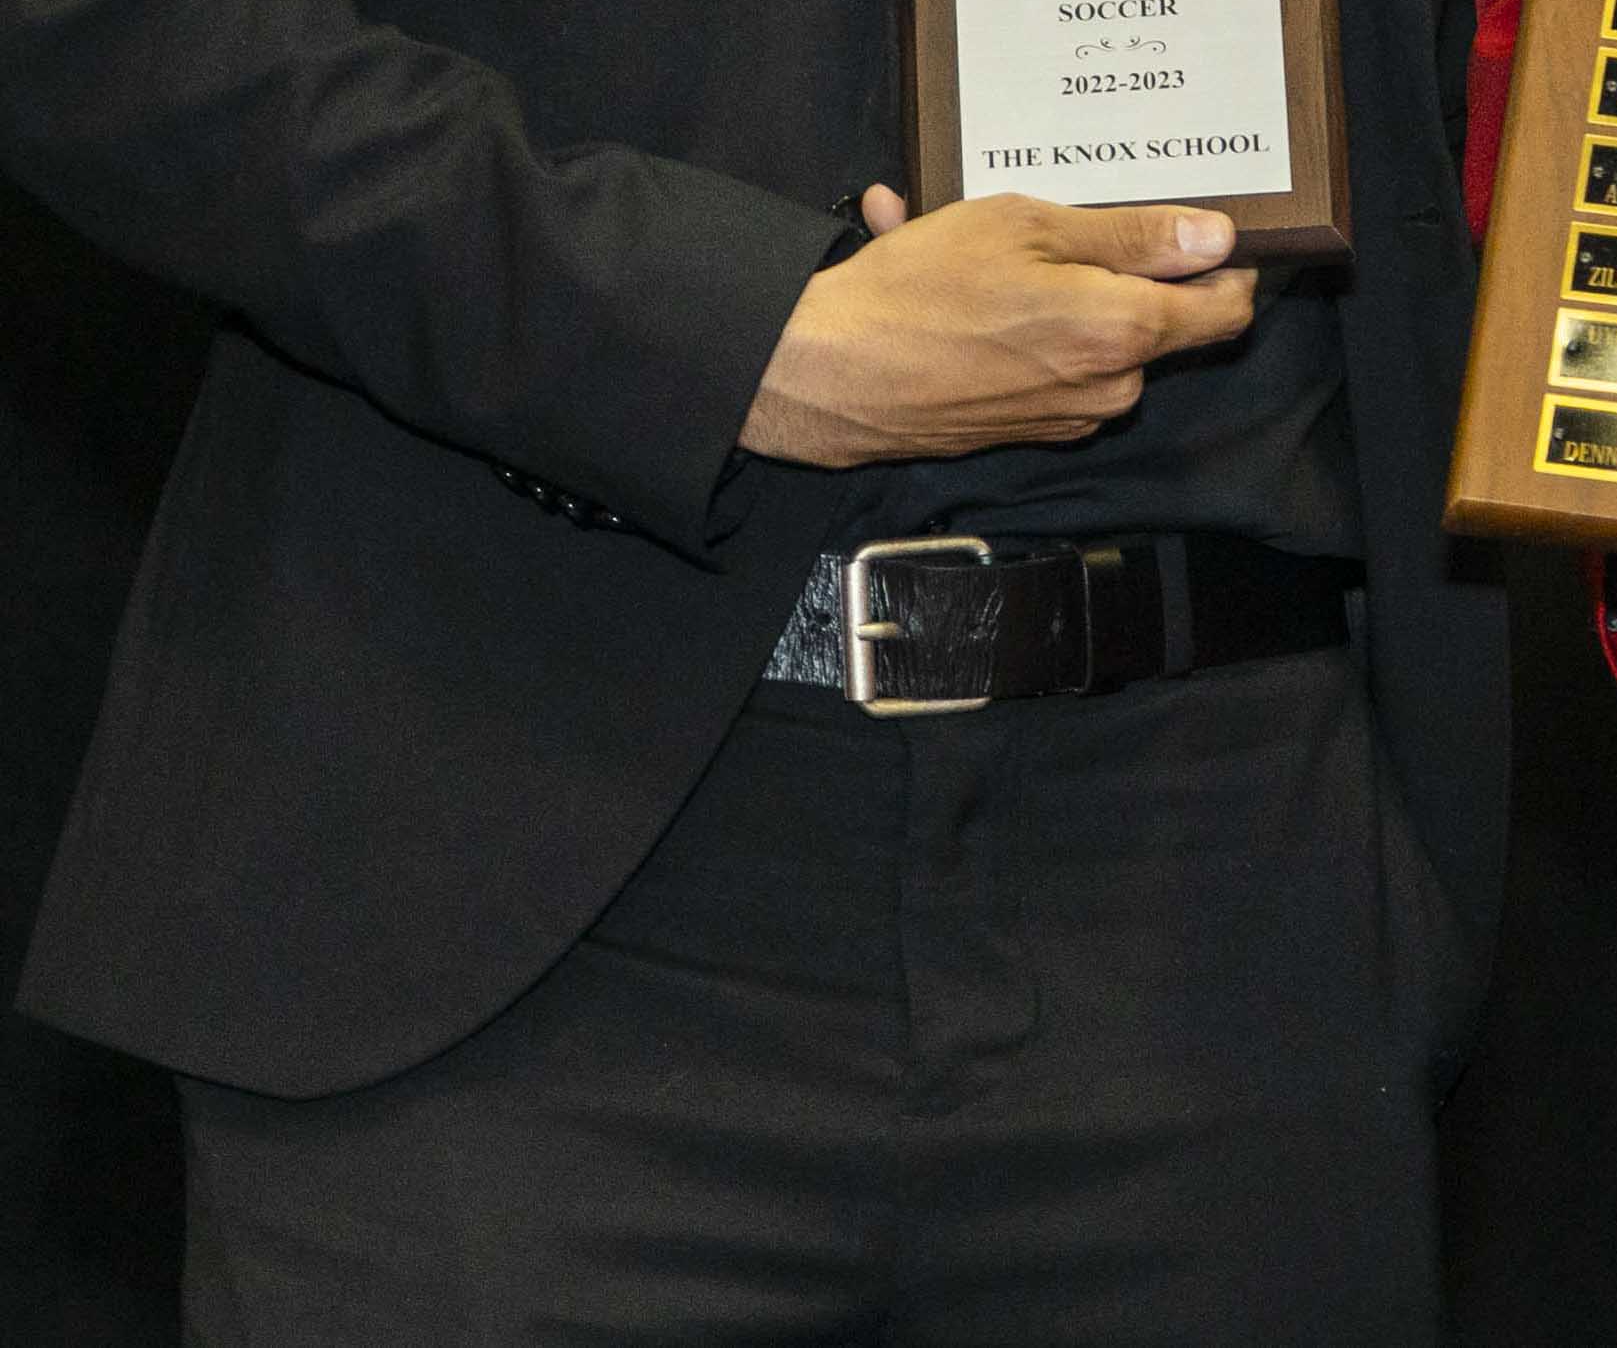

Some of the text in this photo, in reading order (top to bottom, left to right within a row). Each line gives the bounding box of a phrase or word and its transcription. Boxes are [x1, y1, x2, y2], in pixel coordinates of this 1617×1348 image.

[1060, 70, 1186, 96] 2022-2023
[982, 133, 1270, 170] THE KNOX SCHOOL
